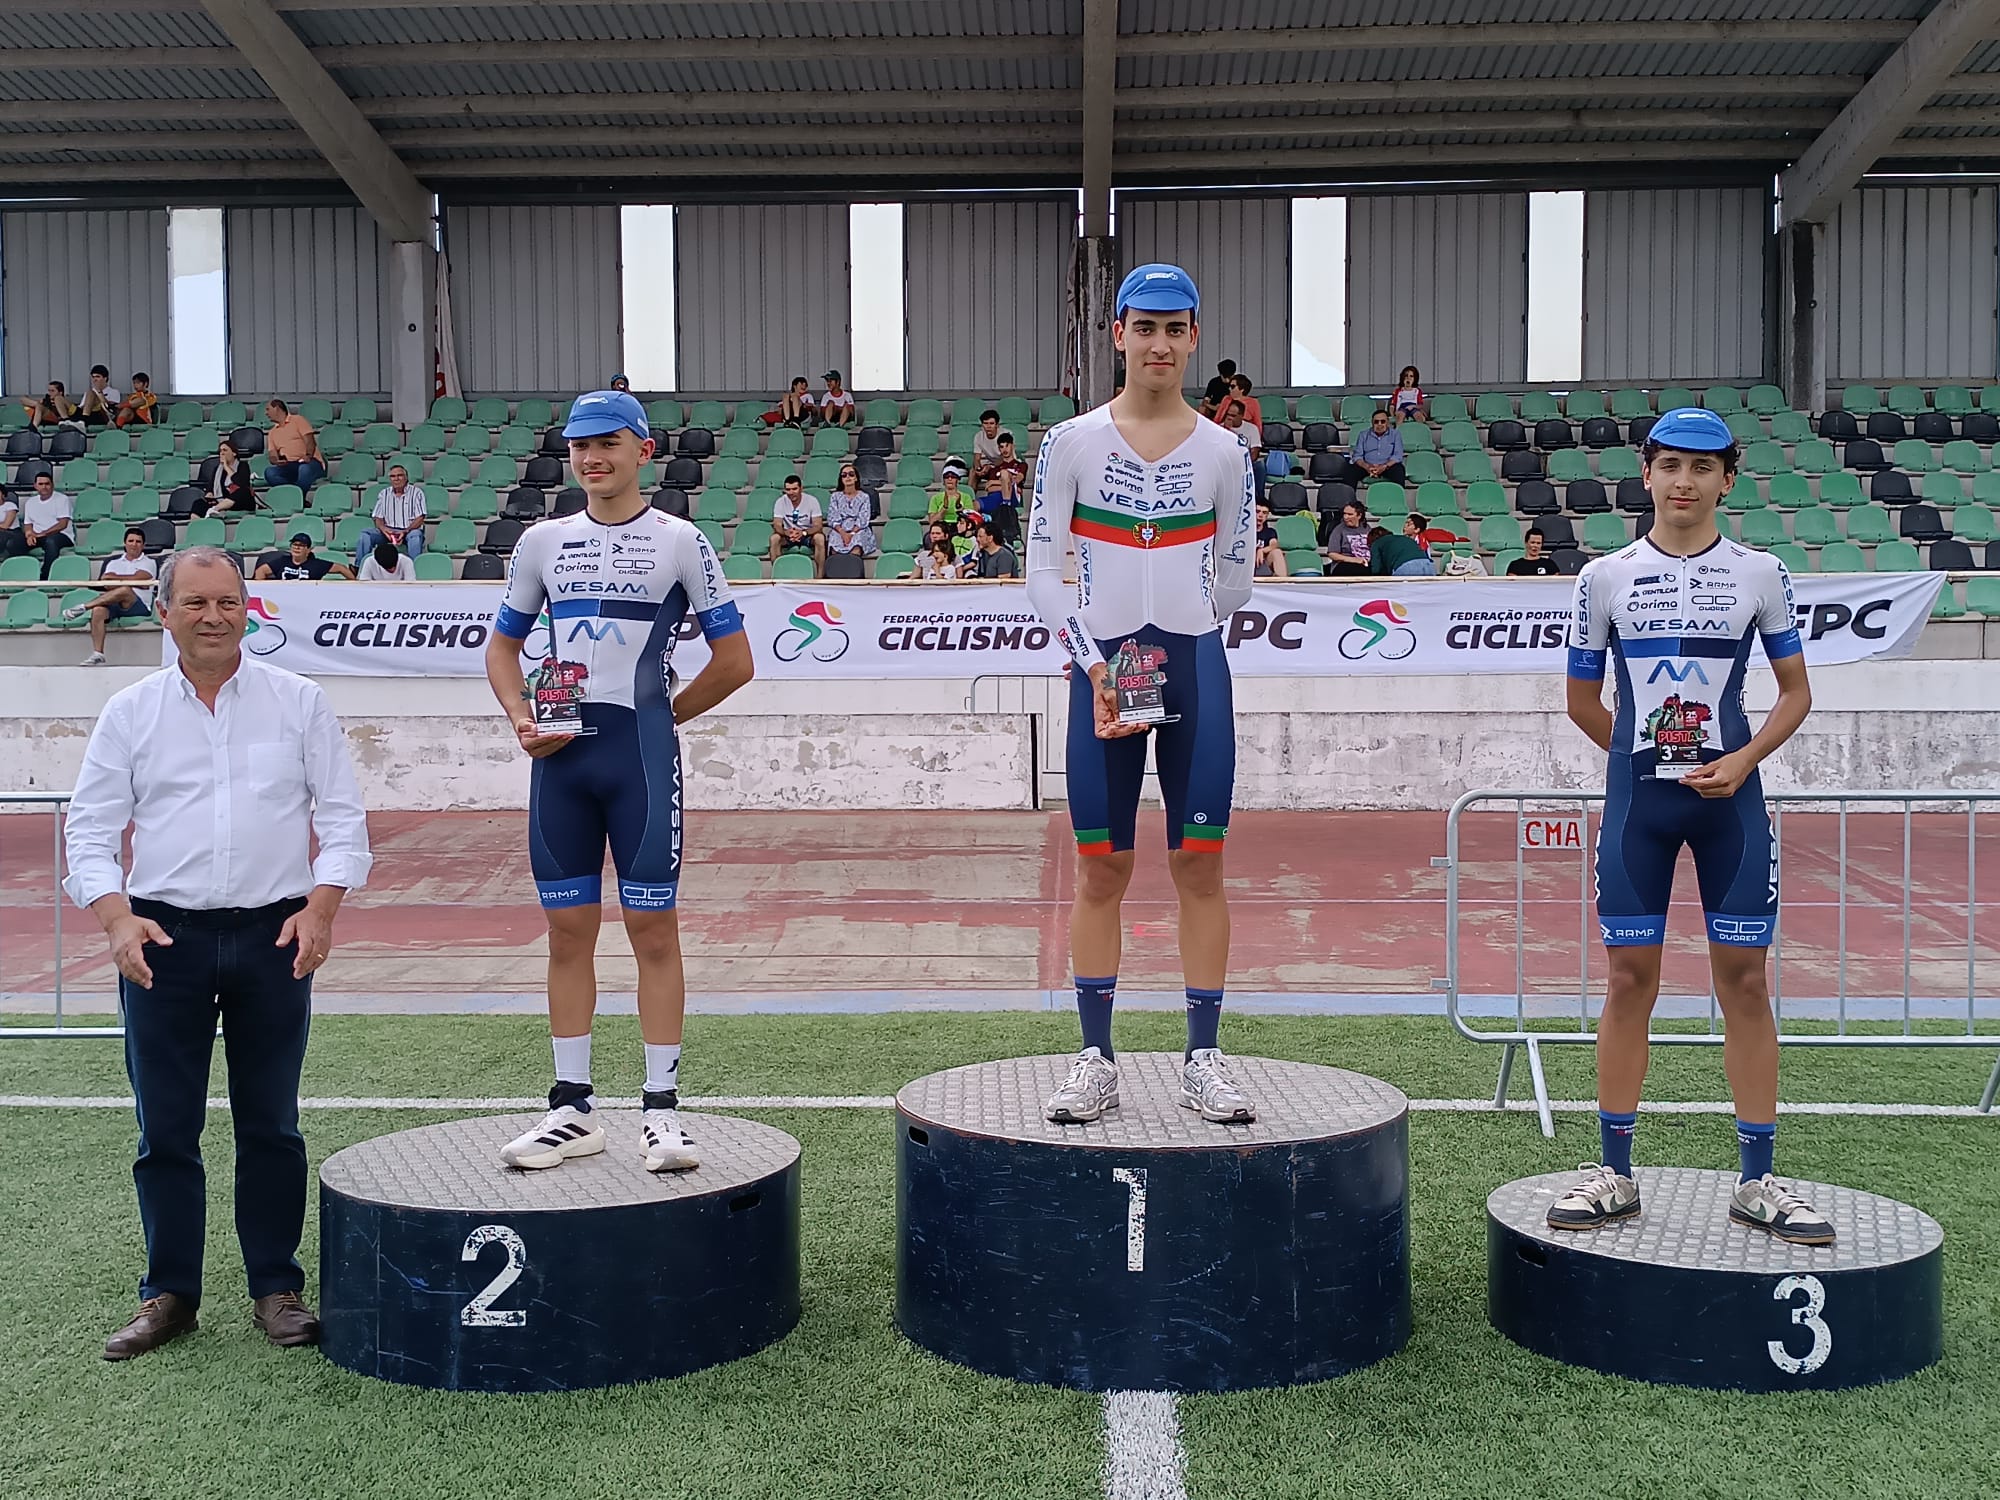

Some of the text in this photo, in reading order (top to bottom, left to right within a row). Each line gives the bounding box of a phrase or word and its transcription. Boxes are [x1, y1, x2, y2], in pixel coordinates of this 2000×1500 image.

[1114, 479, 1143, 493] orima
[1099, 489, 1196, 512] VESAM
[565, 562, 599, 573] orima
[696, 533, 719, 607] VESAM
[557, 581, 649, 596] VESAM
[319, 610, 391, 622] FEDERAÇÃO
[393, 610, 474, 621] PORTUGUESA
[476, 612, 494, 622] DE
[1450, 609, 1523, 623] FEDERAÇÃO
[1579, 573, 1591, 645] VESAM
[1641, 599, 1678, 609] orima
[882, 612, 954, 624] FEDERAÇÃO
[956, 613, 1036, 623] PORTUGUESA
[1221, 610, 1308, 650] PC
[1631, 618, 1730, 633] VESAM
[313, 622, 488, 649] CICLISMO
[878, 626, 1050, 651] CICLISMO
[1445, 623, 1572, 648] CICLIS
[537, 688, 576, 702] PISTA
[1658, 730, 1698, 743] PISTA
[670, 755, 681, 871] VESAM
[1525, 820, 1581, 847] CMA
[1112, 1167, 1148, 1271] 1
[461, 1224, 527, 1327] 2
[1767, 1274, 1832, 1375] 3
